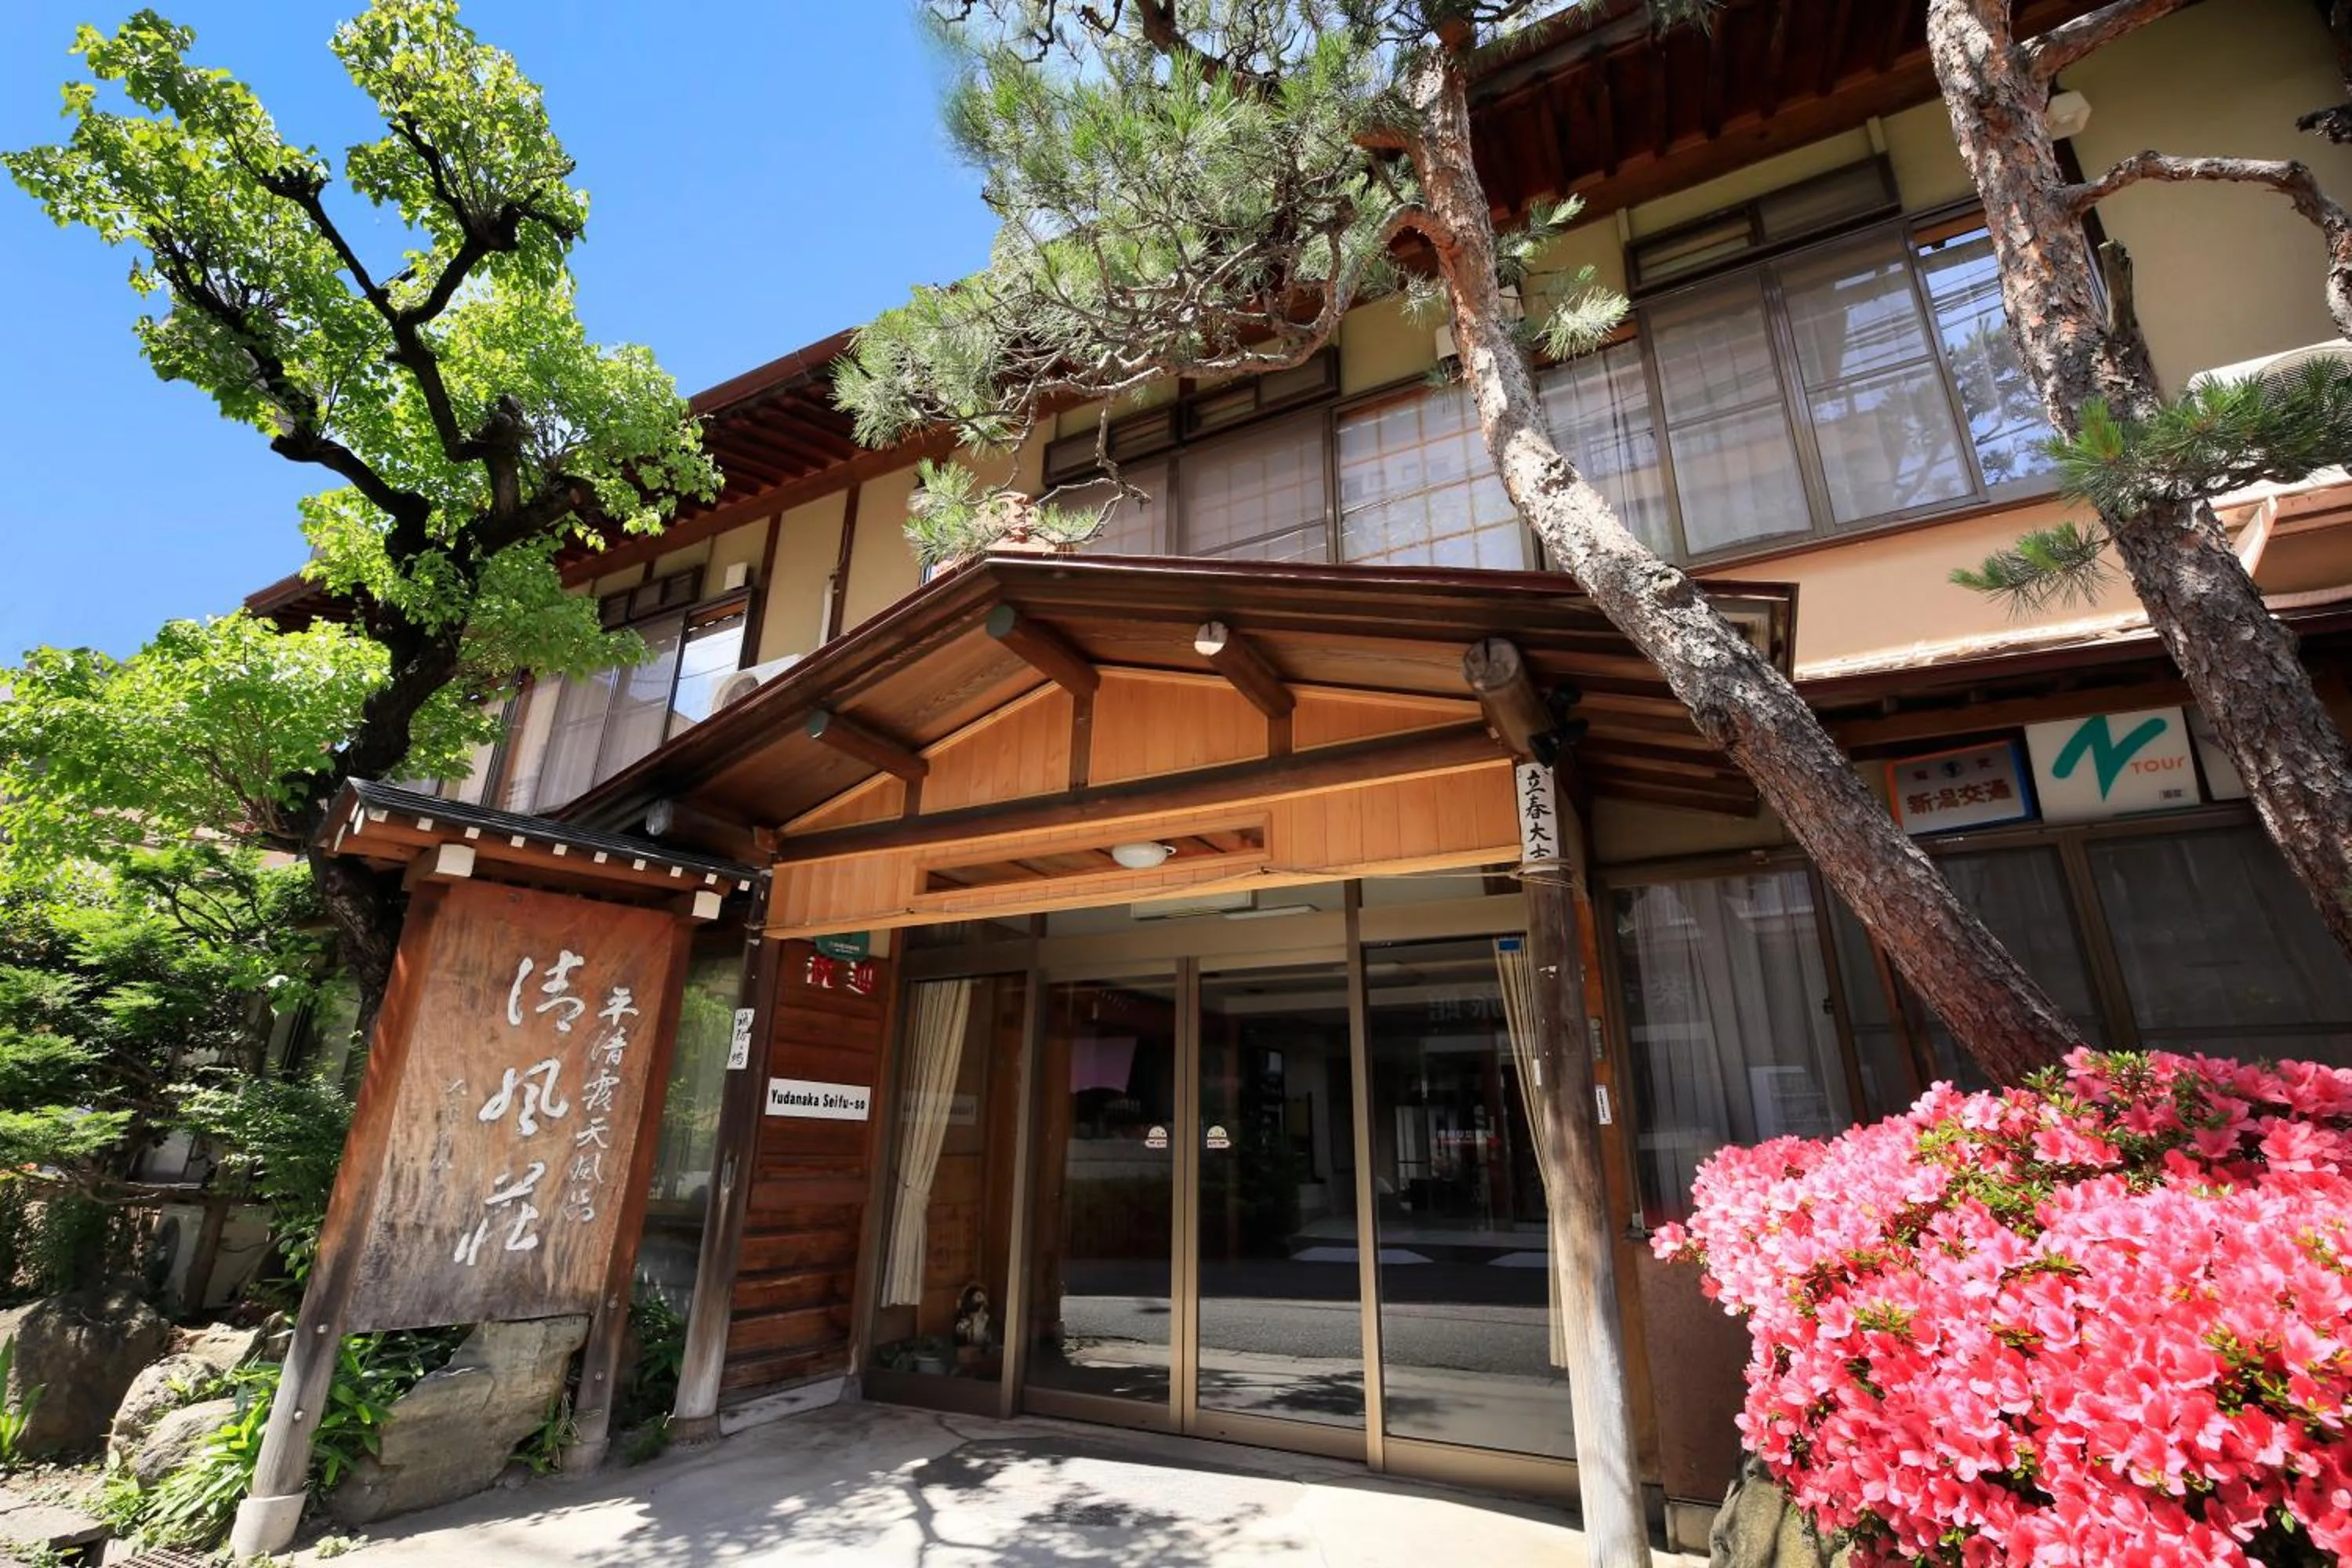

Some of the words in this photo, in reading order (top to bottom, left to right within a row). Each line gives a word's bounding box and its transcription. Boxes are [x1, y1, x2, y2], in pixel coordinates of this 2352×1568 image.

[1907, 778, 2013, 815] 新潟交通
[771, 1089, 819, 1106] Yudanaka
[822, 1094, 866, 1109] Seifu-so
